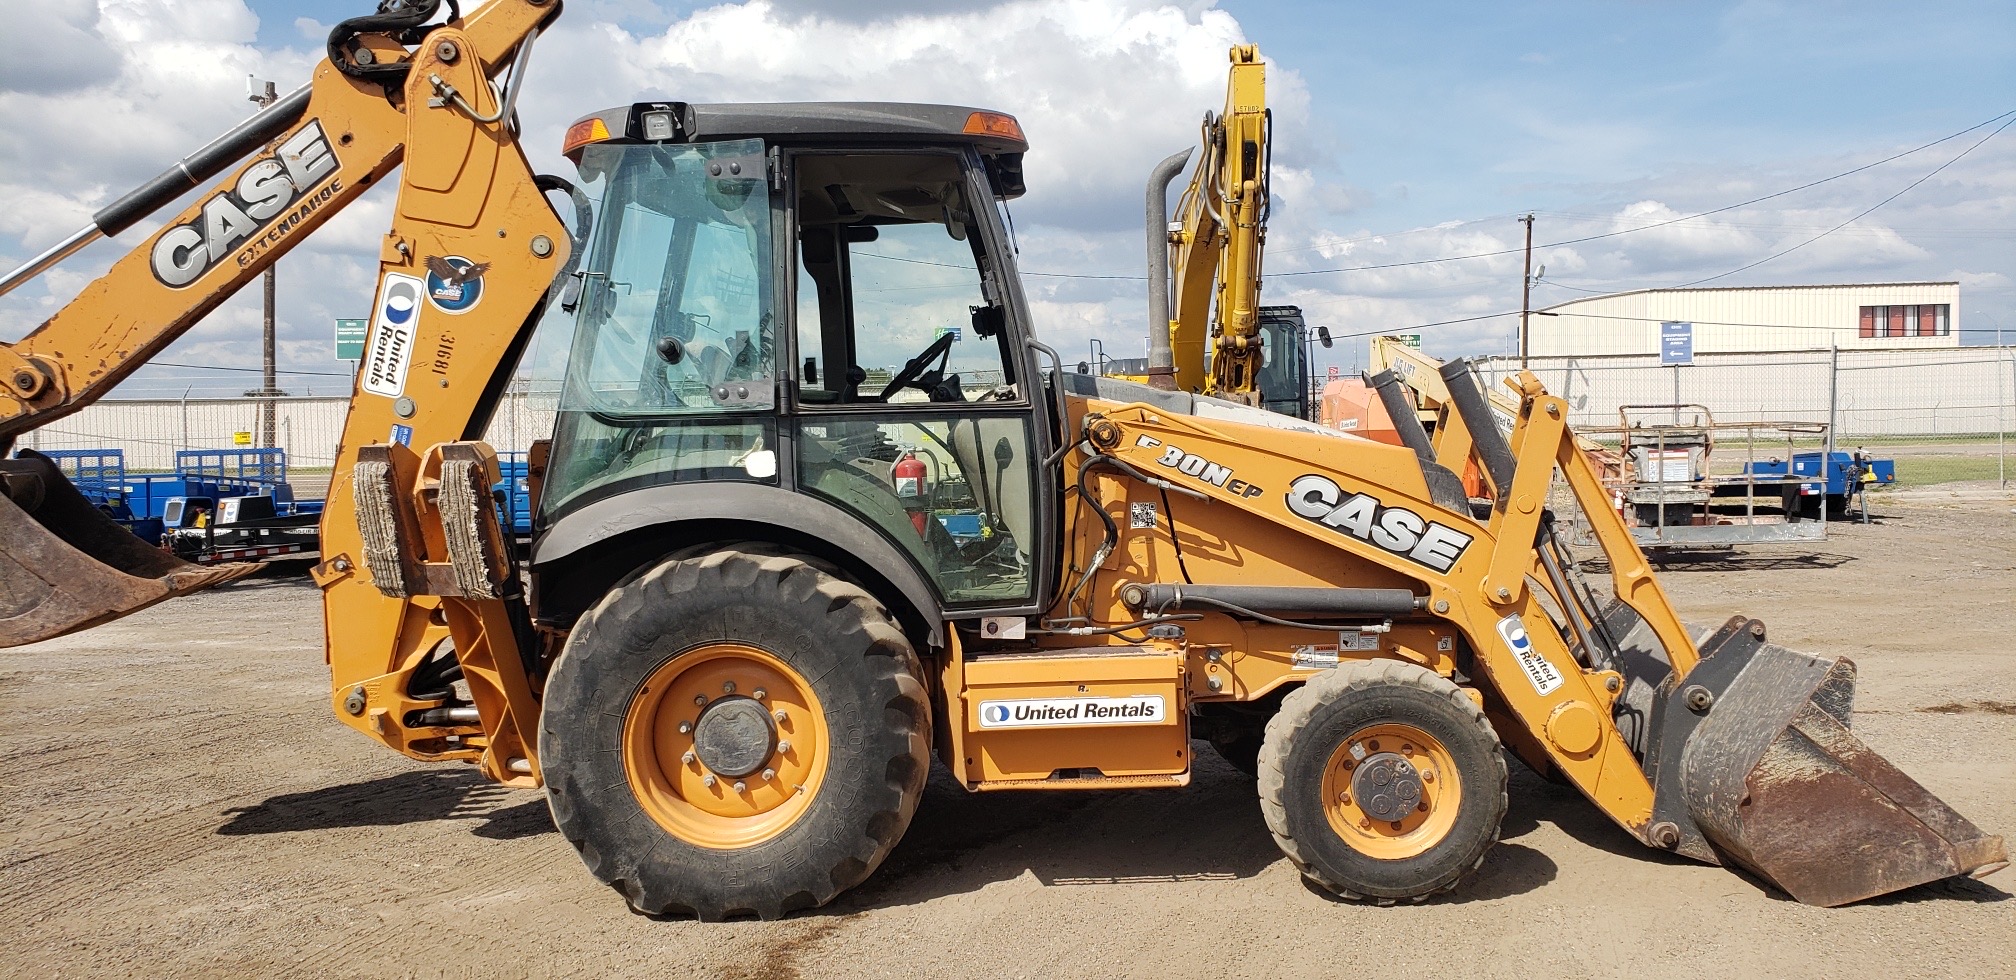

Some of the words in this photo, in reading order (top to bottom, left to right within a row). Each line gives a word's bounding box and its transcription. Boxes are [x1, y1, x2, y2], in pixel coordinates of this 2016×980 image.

[153, 120, 339, 287] CASE
[370, 325, 394, 386] Rentals
[385, 329, 408, 386] United
[1226, 478, 1264, 499] EP
[1286, 474, 1473, 573] CASE
[1520, 650, 1548, 690] Rentals
[1532, 650, 1557, 681] nited
[1014, 703, 1079, 720] United
[1084, 702, 1155, 718] Rentals
